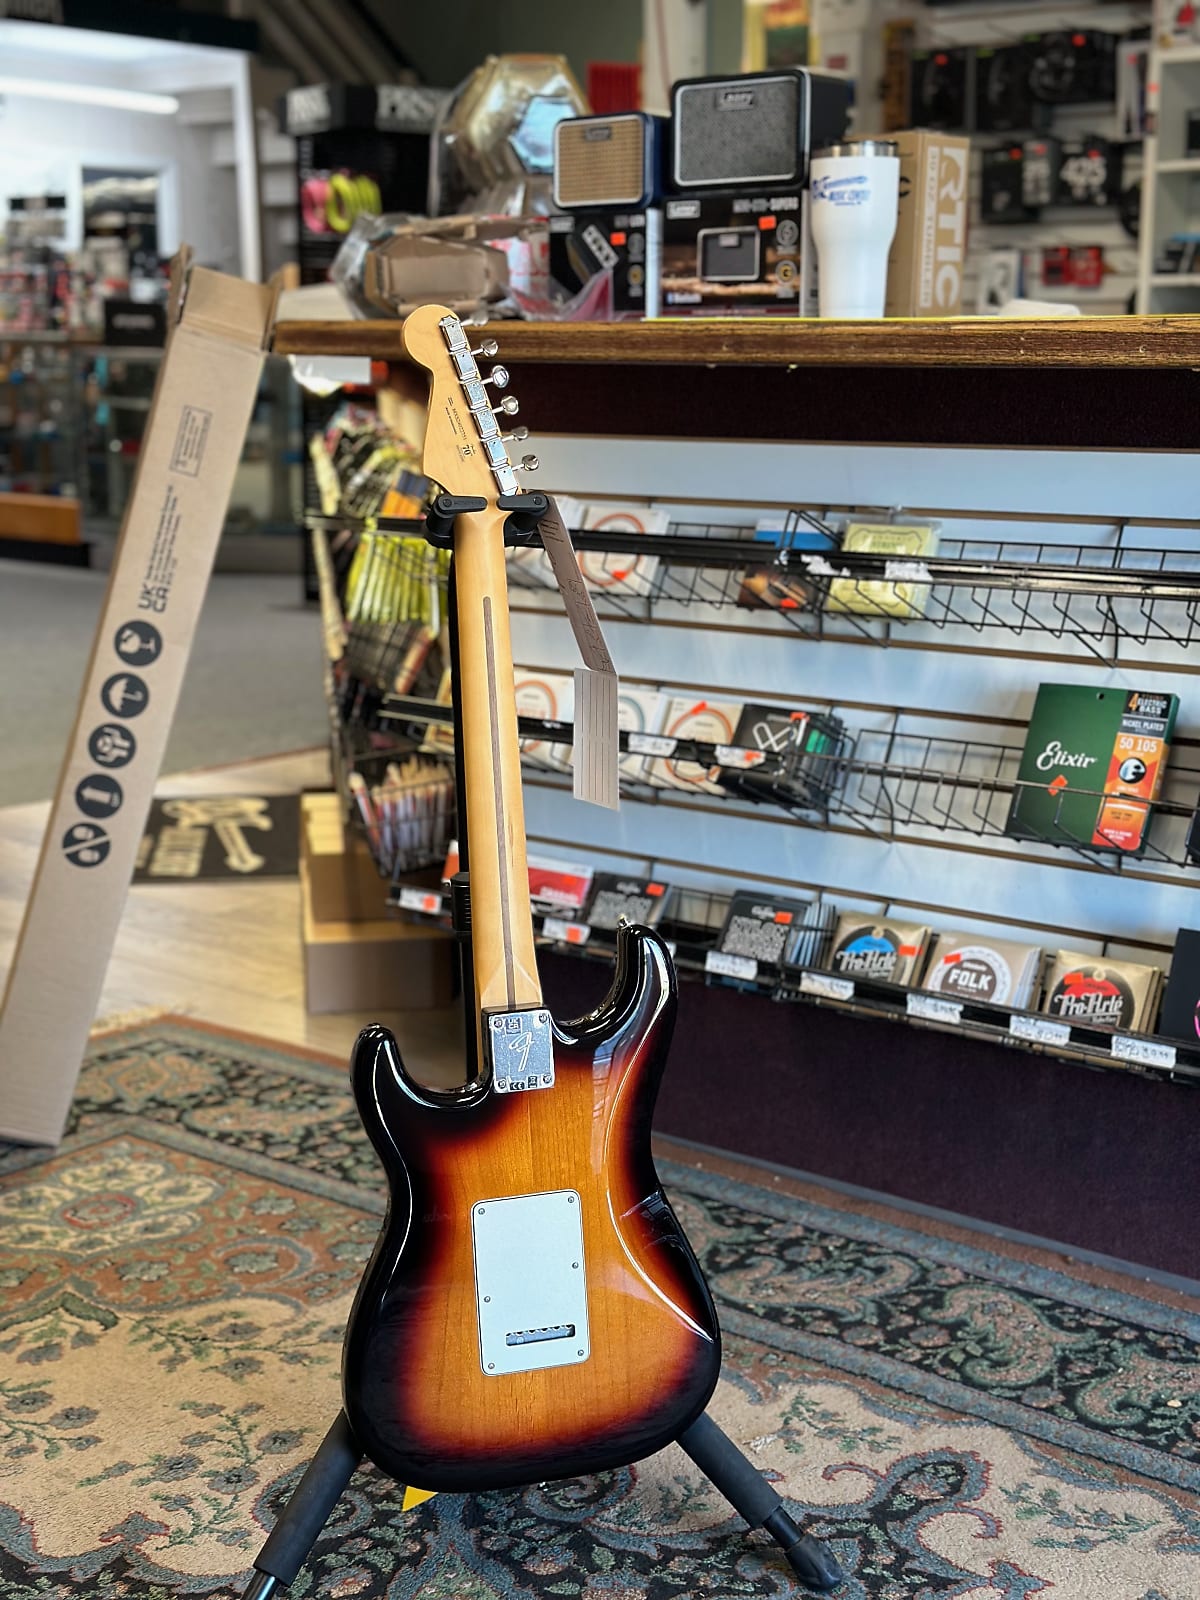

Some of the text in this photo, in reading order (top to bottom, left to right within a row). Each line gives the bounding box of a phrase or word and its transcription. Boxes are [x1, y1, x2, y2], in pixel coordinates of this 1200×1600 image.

[936, 146, 970, 309] RTIC
[137, 583, 156, 610] UK
[152, 585, 169, 613] CA
[1128, 693, 1138, 712] 4
[1137, 698, 1167, 709] ELECTRIC
[1138, 704, 1162, 714] BASS
[1122, 718, 1164, 731] NICKEL PLATED
[1119, 736, 1157, 752] 50 105
[1036, 741, 1097, 770] Elixir
[947, 968, 992, 989] FOLK
[1053, 990, 1124, 1017] Pro-Arté
